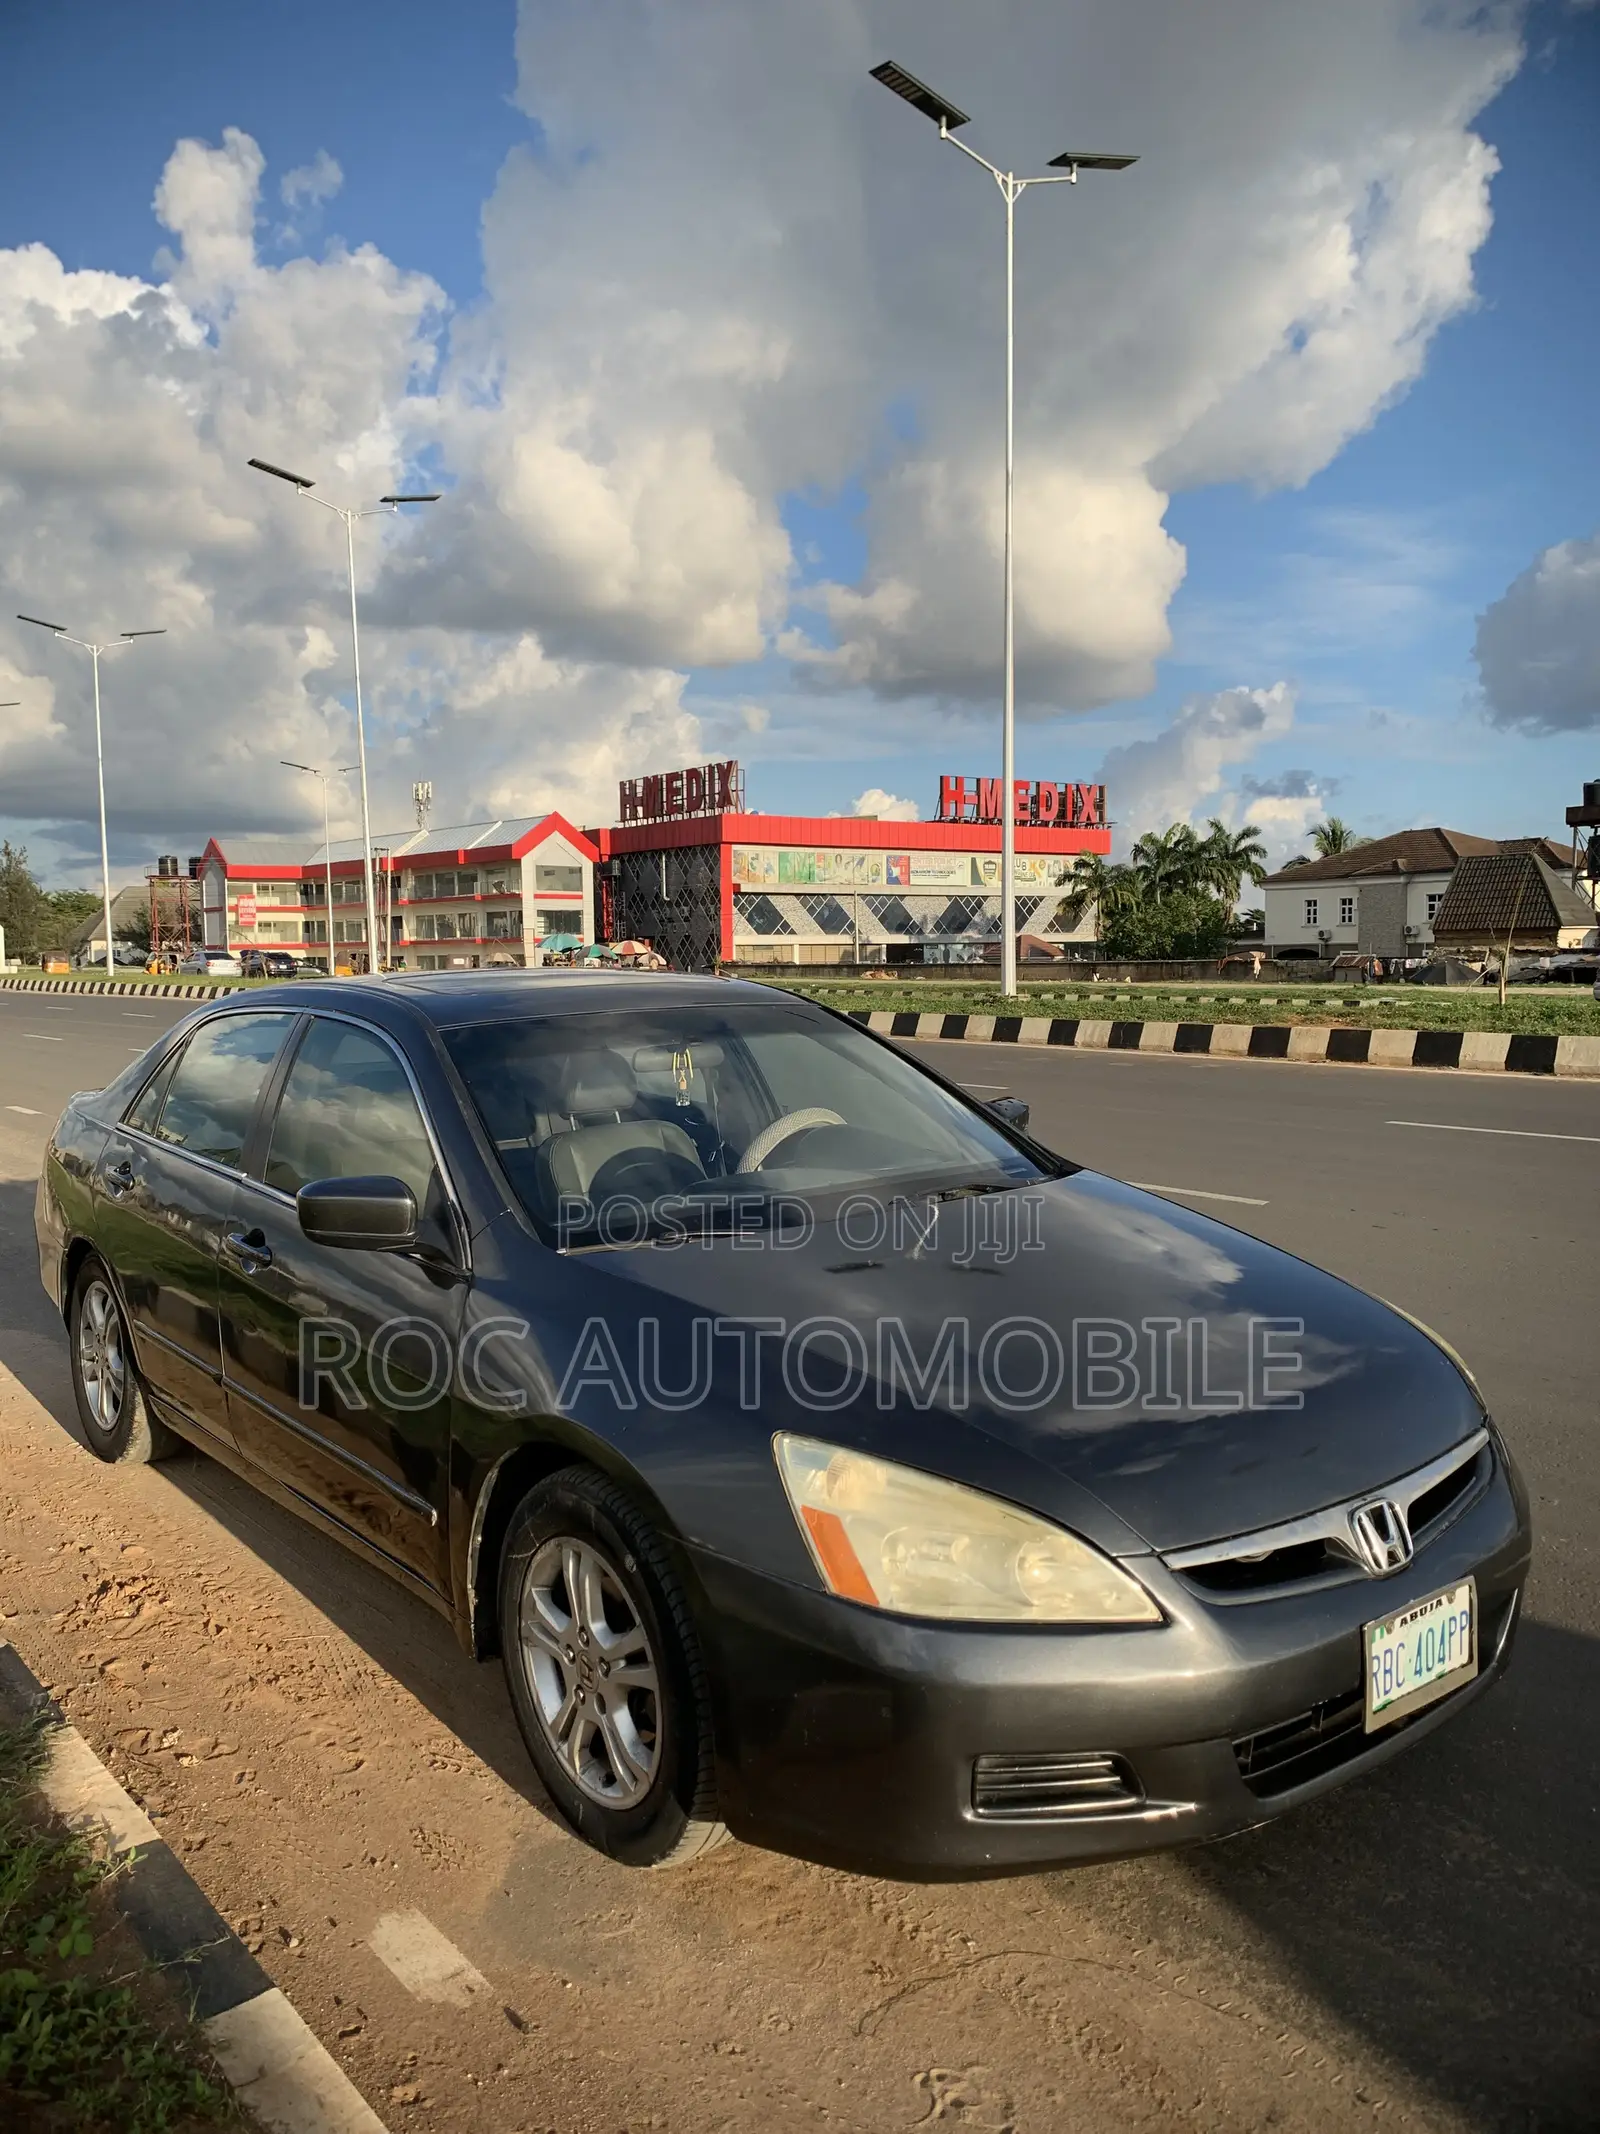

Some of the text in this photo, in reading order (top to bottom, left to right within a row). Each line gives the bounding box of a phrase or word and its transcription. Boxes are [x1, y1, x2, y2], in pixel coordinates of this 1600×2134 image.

[619, 760, 737, 822] H-MEDIX
[940, 776, 1100, 823] H-MEDIX
[1400, 1598, 1443, 1627] ABUJA
